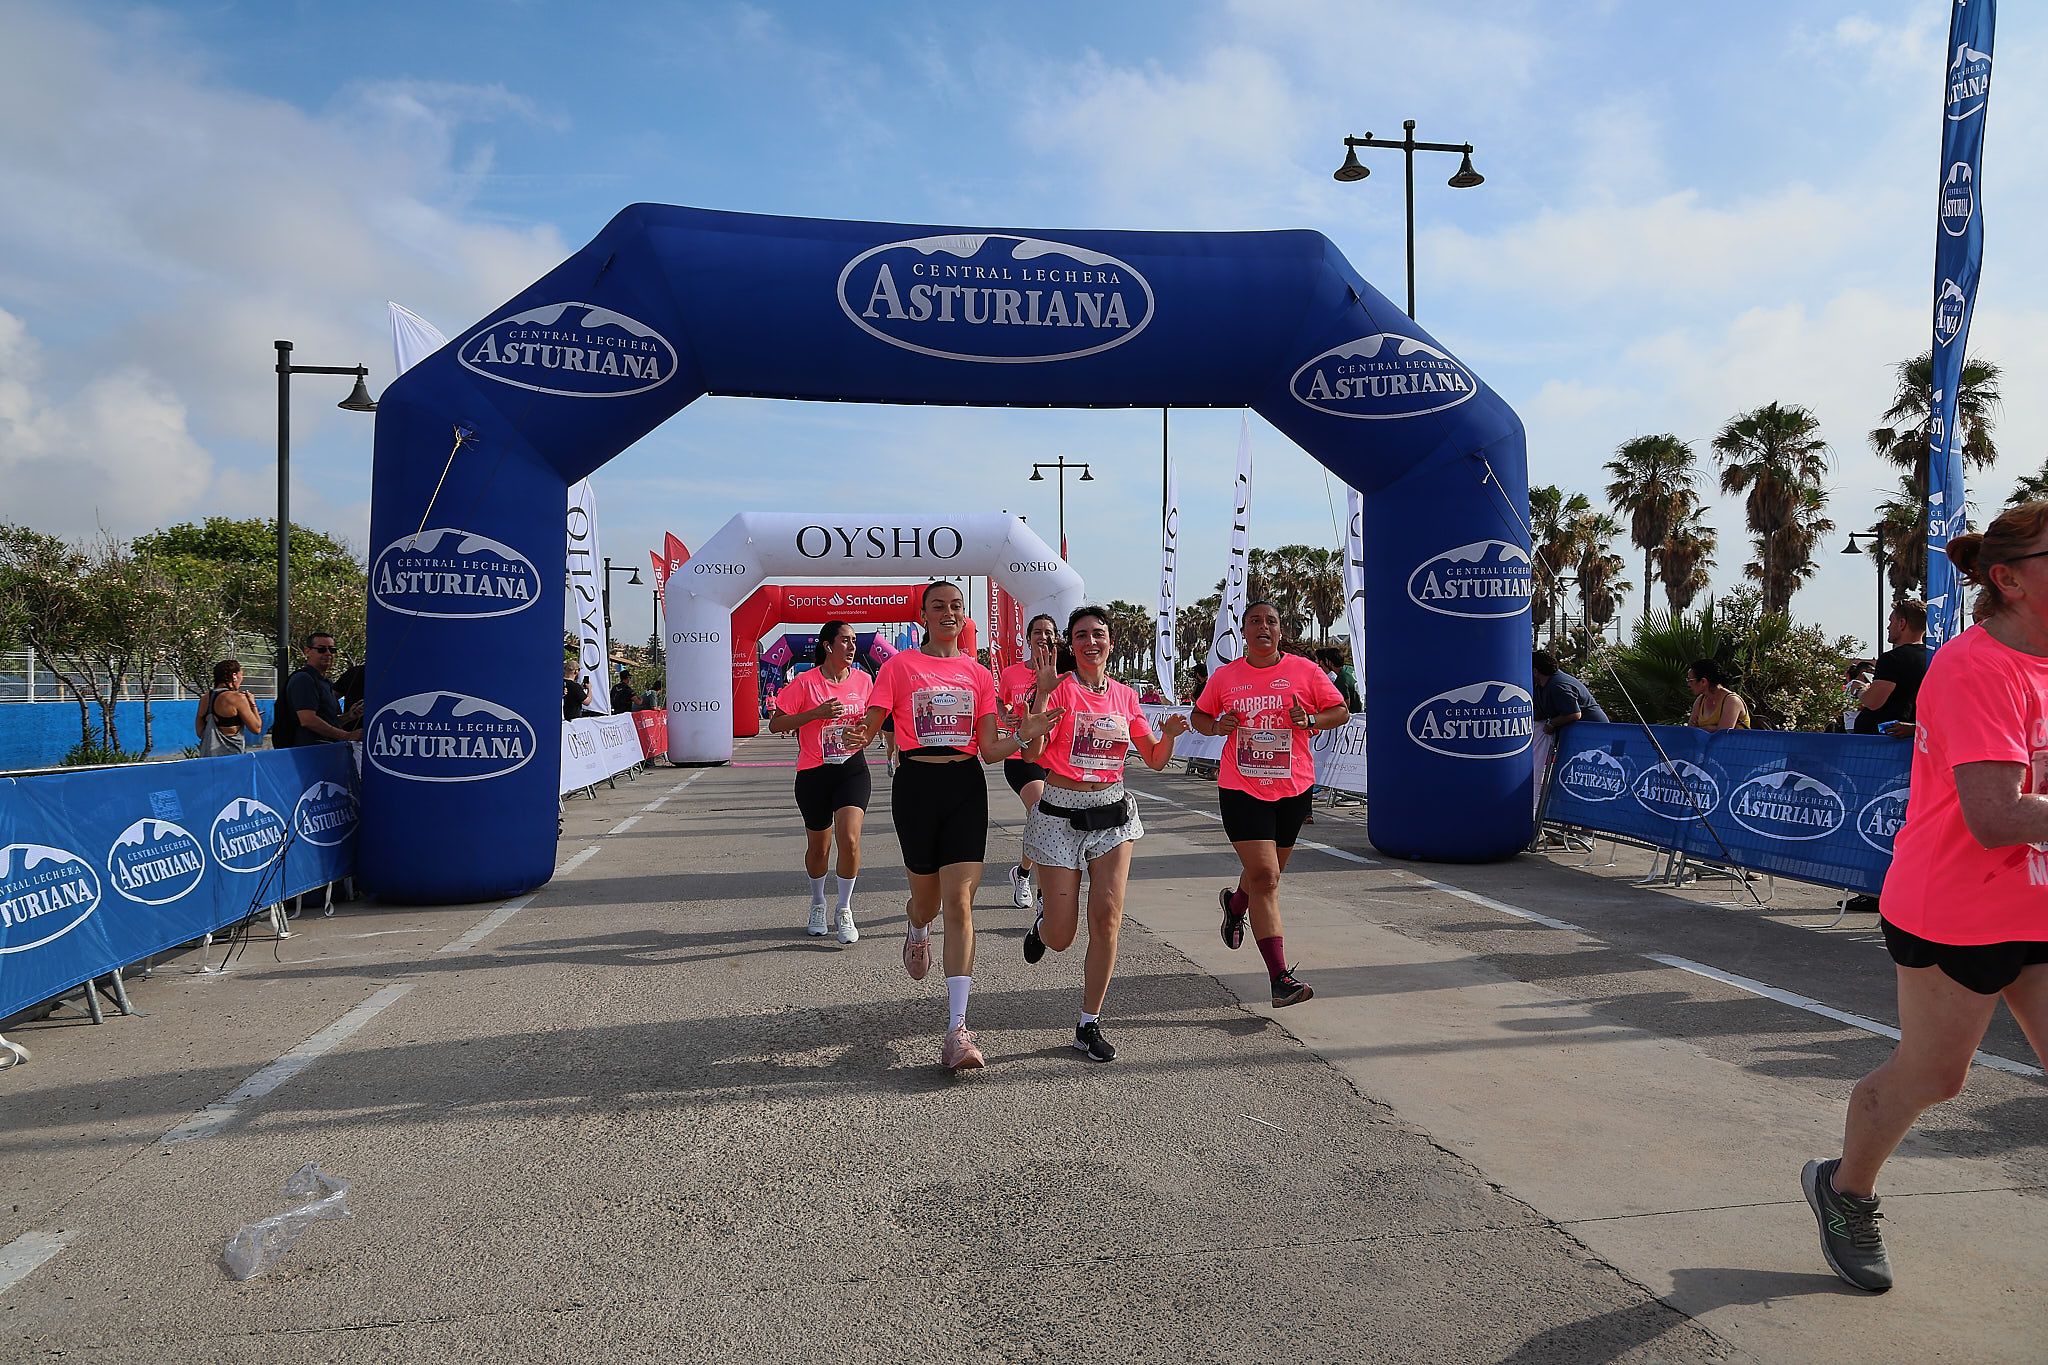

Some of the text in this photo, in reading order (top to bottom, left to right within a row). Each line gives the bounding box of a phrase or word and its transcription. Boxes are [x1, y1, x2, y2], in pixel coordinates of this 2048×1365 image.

[913, 263, 1121, 284] CENTRAL LECHERA
[862, 264, 1131, 329] ASTURIANA
[509, 330, 657, 352] CENTRAL LECHERA
[469, 333, 661, 380] ASTURIANA
[1337, 360, 1456, 374] CENTRAL LECHERA
[1305, 369, 1470, 400] ASTURIANA
[796, 525, 963, 559] OYSHO
[397, 558, 525, 574] CENTRAL LECHERA
[694, 563, 746, 575] OYSHO
[1009, 561, 1058, 573] OYSHO
[1446, 566, 1530, 576] CENTRAL LECHER
[377, 561, 530, 600] ASTURIANA
[788, 594, 909, 609] Sports Santander
[672, 632, 720, 643] OYSHO
[672, 700, 720, 712] OYSHO
[1445, 705, 1531, 716] CENTRAL LECHER
[392, 721, 520, 733] CENTRAL LECHERA
[934, 715, 958, 725] 016
[372, 722, 525, 759] ASTURIANA
[1092, 738, 1113, 749] 016
[1314, 726, 1366, 755] OYSH
[1252, 751, 1274, 760] 016
[1735, 790, 1833, 828] ASTURIANA
[127, 840, 191, 861] CENTRAL LECHERA
[219, 825, 282, 861] ASTURIANA
[118, 850, 201, 890] ASTURIANA
[0, 865, 82, 897] NTRAL LECHERA
[0, 878, 95, 928] TURIANA
